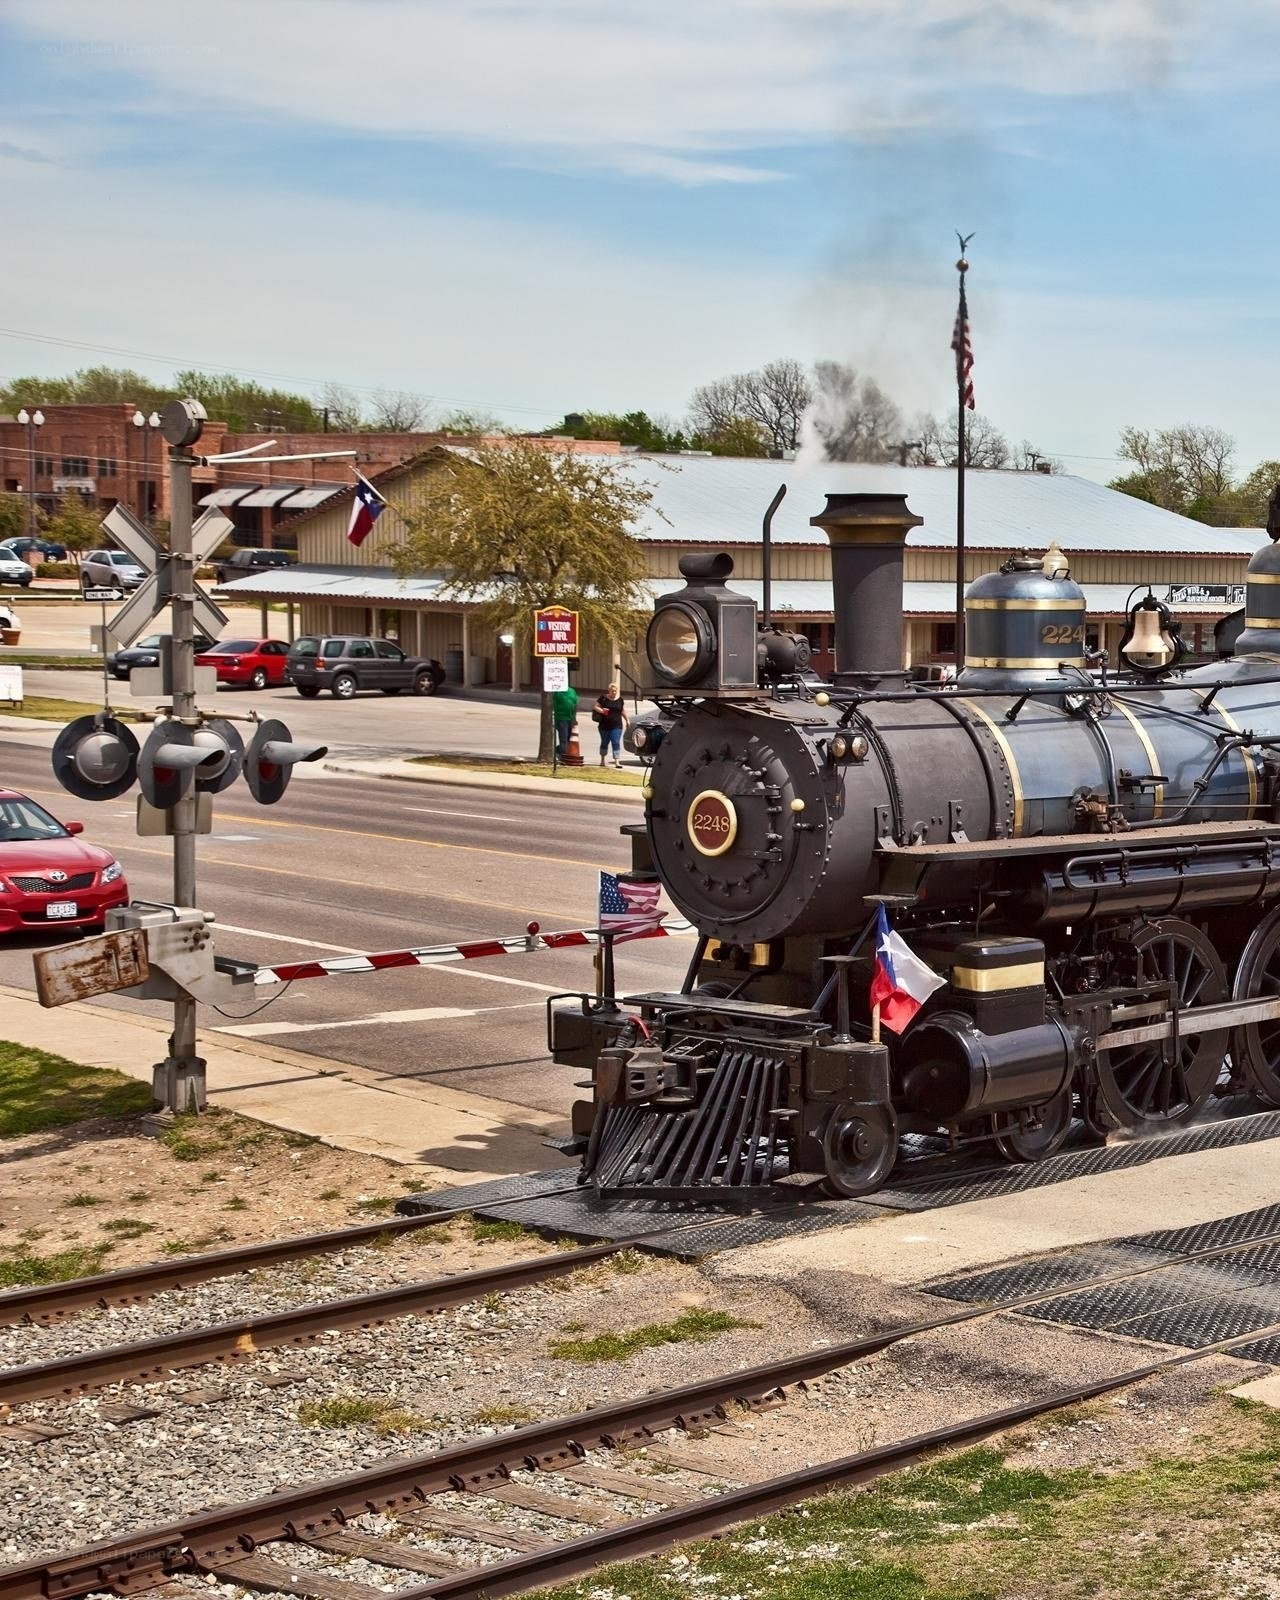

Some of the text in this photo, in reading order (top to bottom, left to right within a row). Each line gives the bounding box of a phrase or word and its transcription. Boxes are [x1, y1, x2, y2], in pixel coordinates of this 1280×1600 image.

[548, 621, 571, 631] VISITOR
[552, 631, 568, 641] INFO.
[538, 643, 556, 653] TRAIN
[556, 643, 576, 654] DEPOT
[694, 814, 730, 833] 2248
